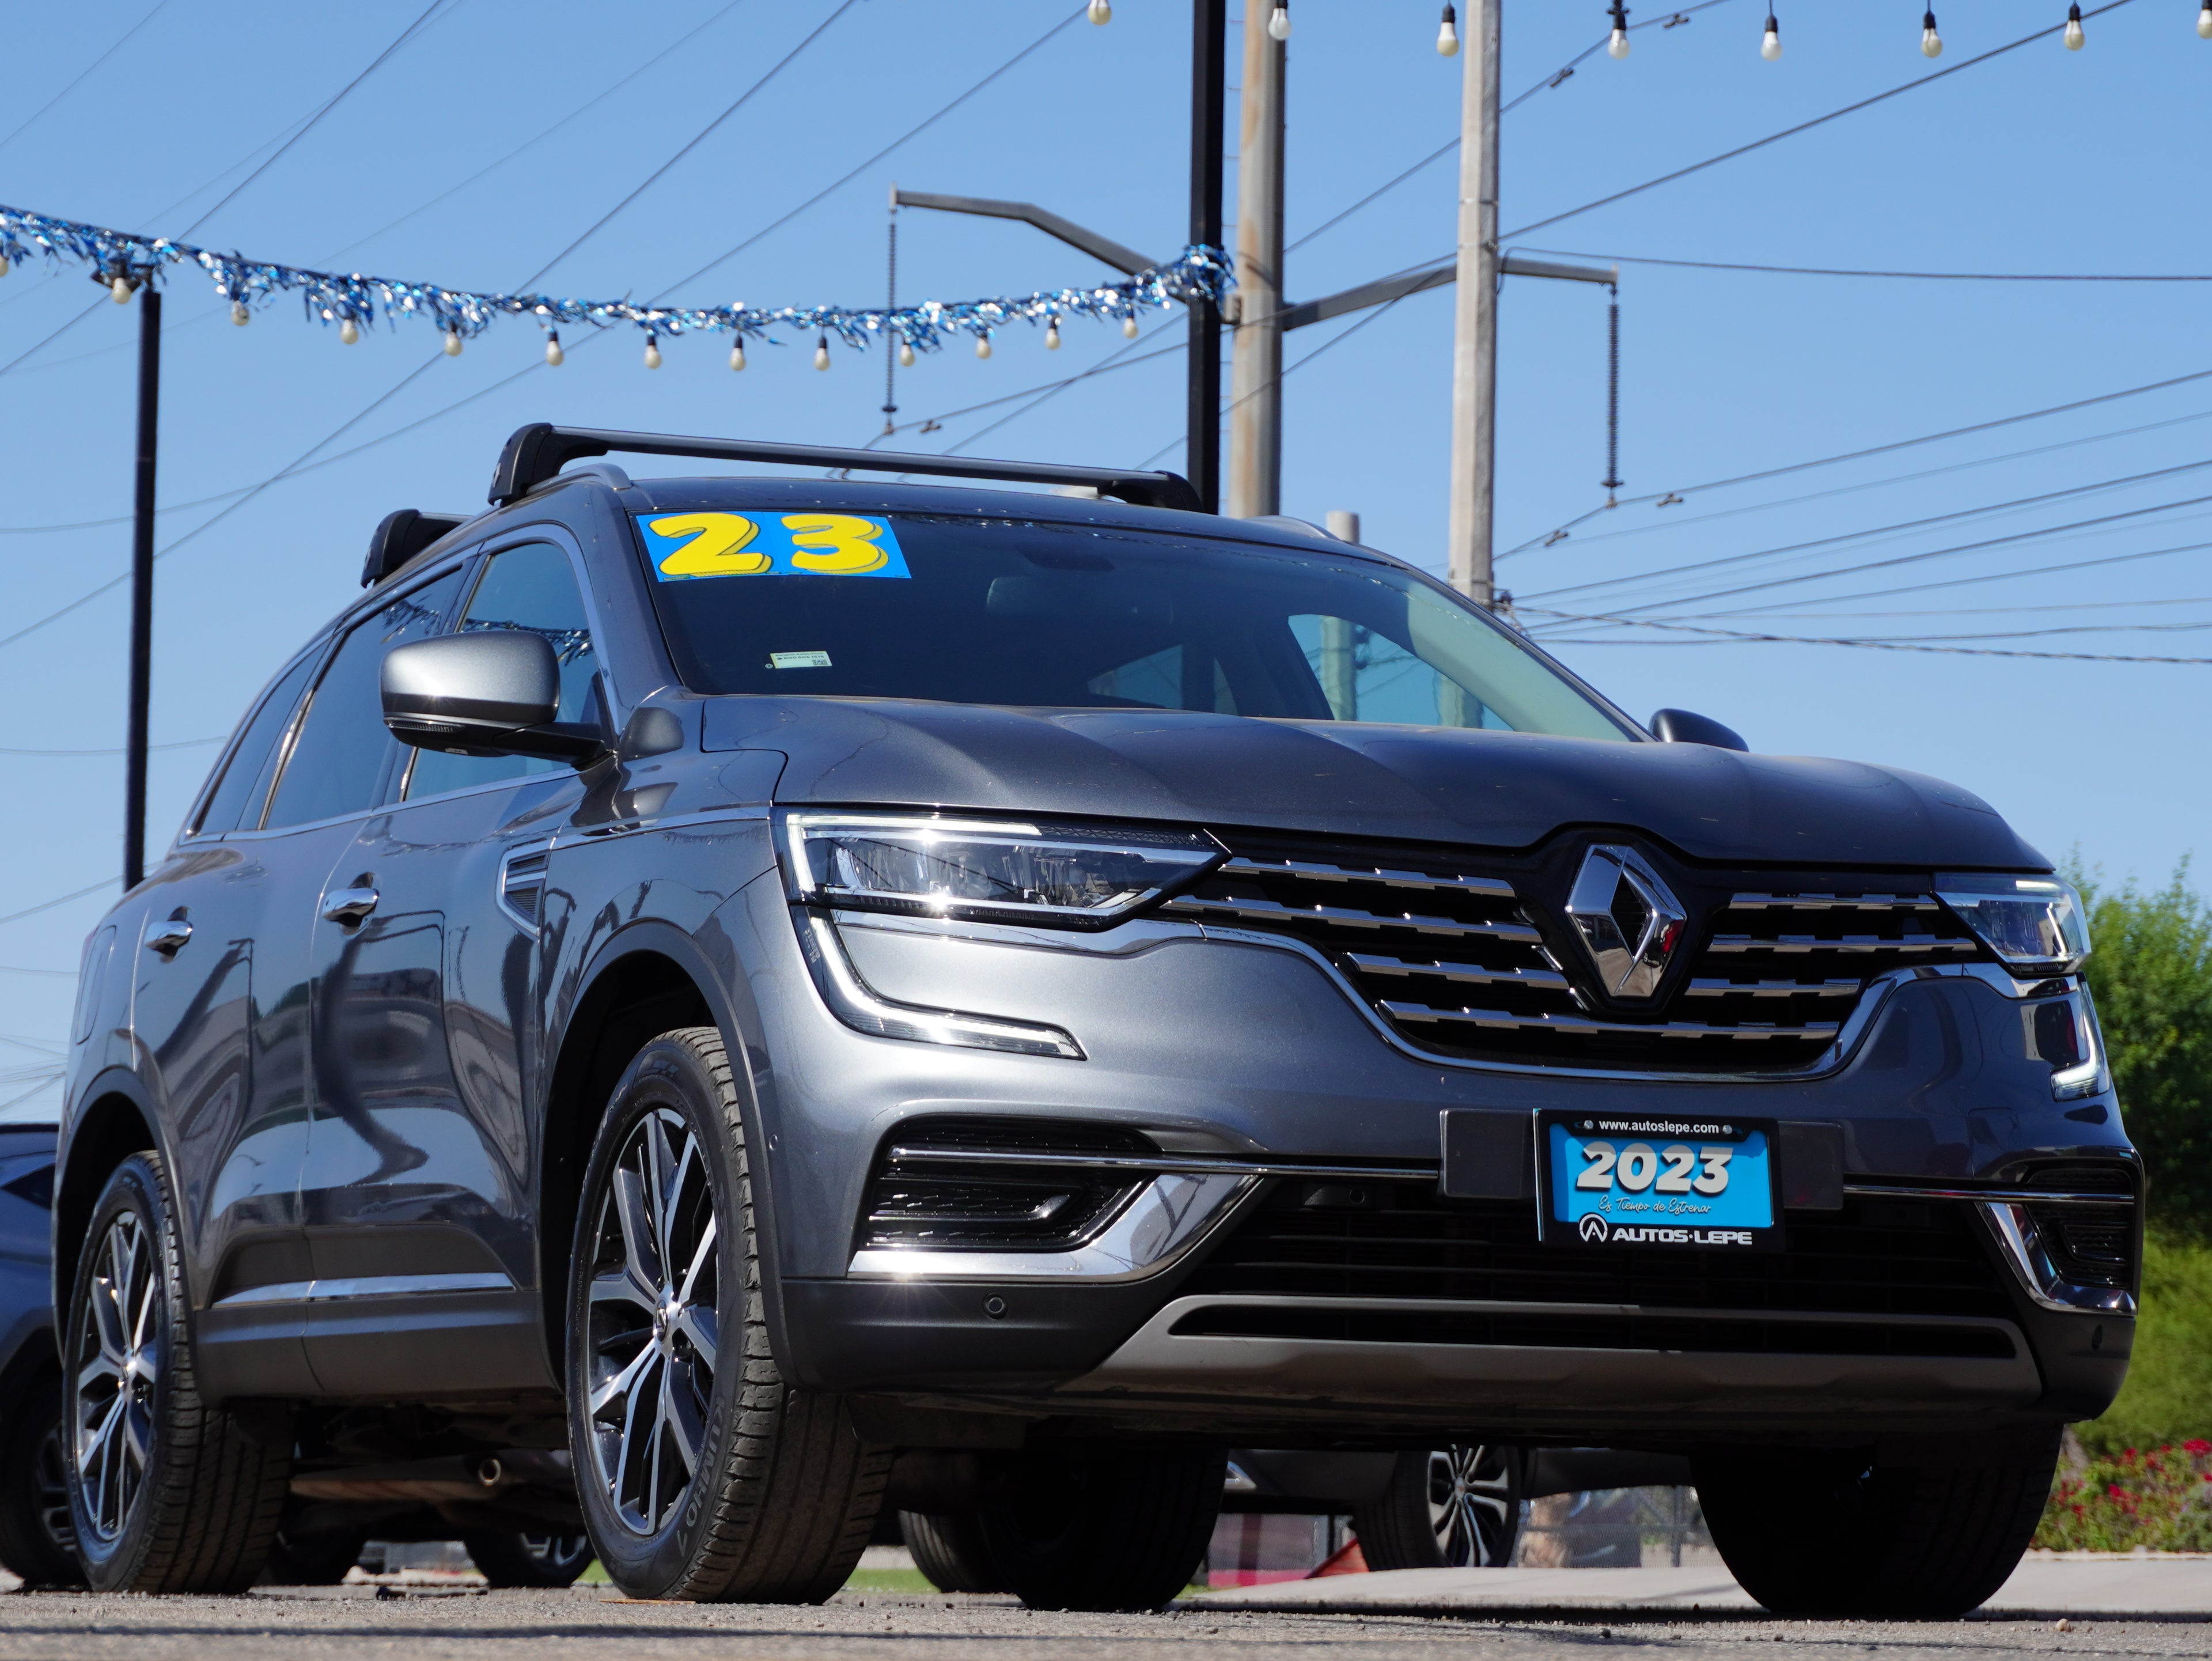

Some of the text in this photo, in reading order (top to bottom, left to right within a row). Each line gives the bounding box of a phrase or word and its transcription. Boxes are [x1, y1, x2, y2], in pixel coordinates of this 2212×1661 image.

[1599, 1119, 1719, 1135] www.autoslepe.com
[1577, 1141, 1733, 1194] 2023
[1599, 1194, 1711, 1214] Es Tiempo de Estrenar
[686, 1397, 725, 1527] KUMHO
